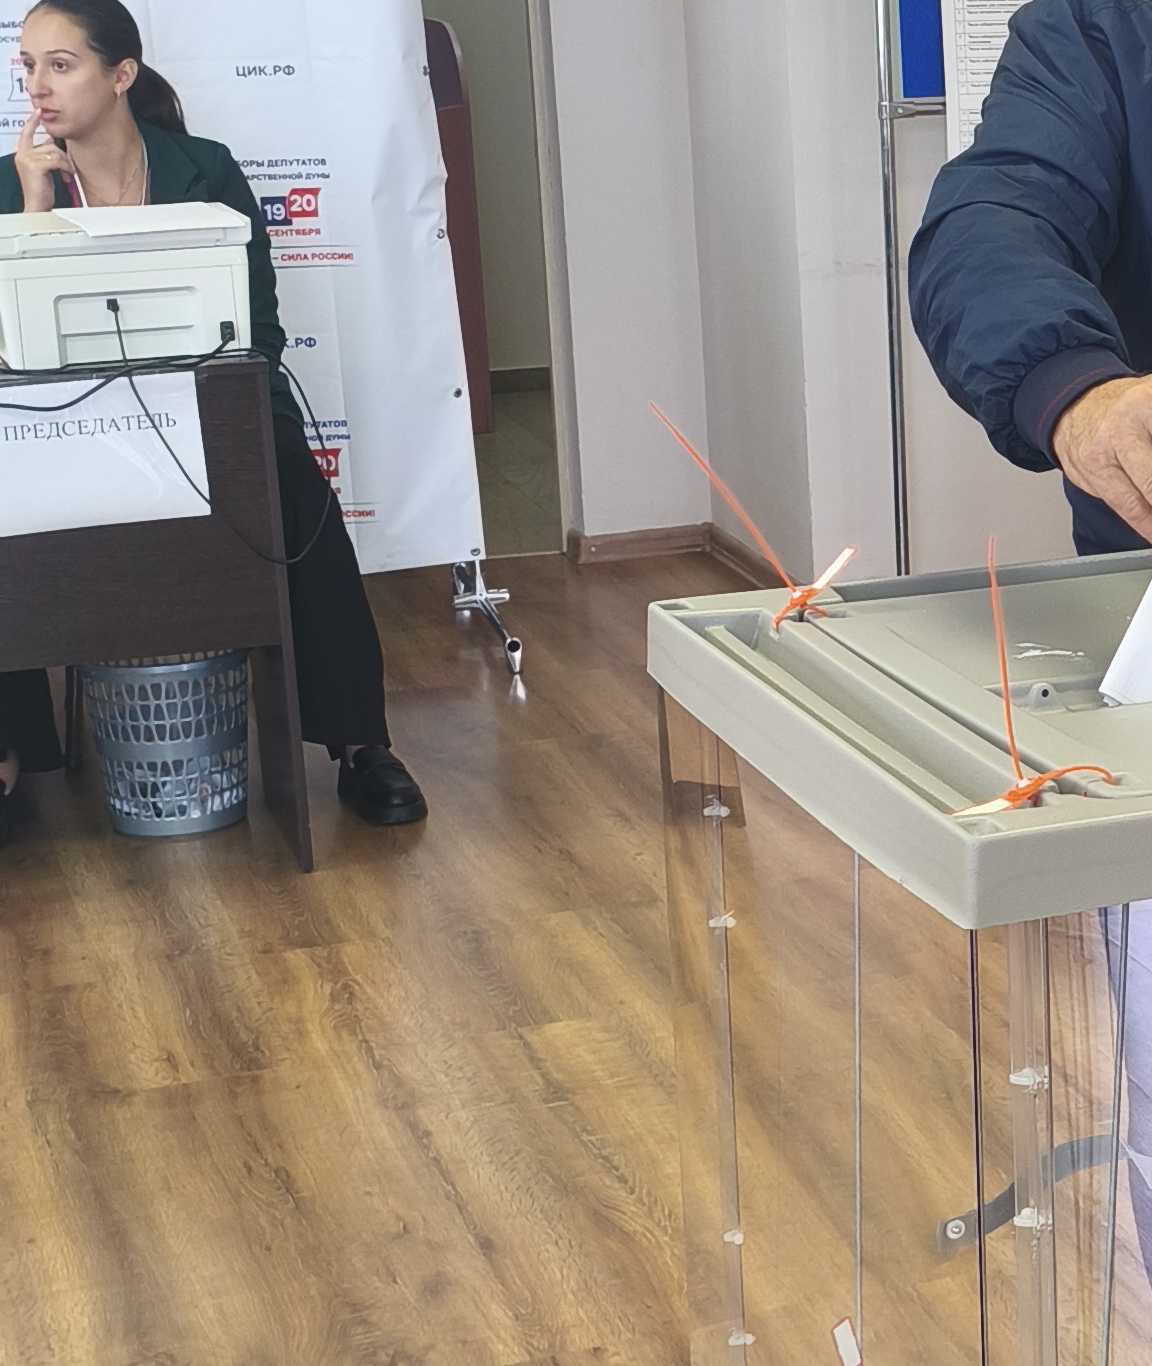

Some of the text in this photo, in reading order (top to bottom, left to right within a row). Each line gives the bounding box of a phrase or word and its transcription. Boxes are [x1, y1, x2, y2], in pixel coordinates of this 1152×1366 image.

[236, 65, 295, 78] ЦИК.РФ
[267, 159, 326, 168] ДЕПУТАТОВ
[245, 172, 303, 181] АРСТВЕННОЙ
[264, 194, 316, 220] 19 20
[268, 228, 321, 237] СЕНТЯБРЯ
[281, 254, 309, 262] СИЛА
[285, 337, 316, 348] К.РФ
[3, 413, 177, 441] ПРЕДСЕДАТЕЛЬ
